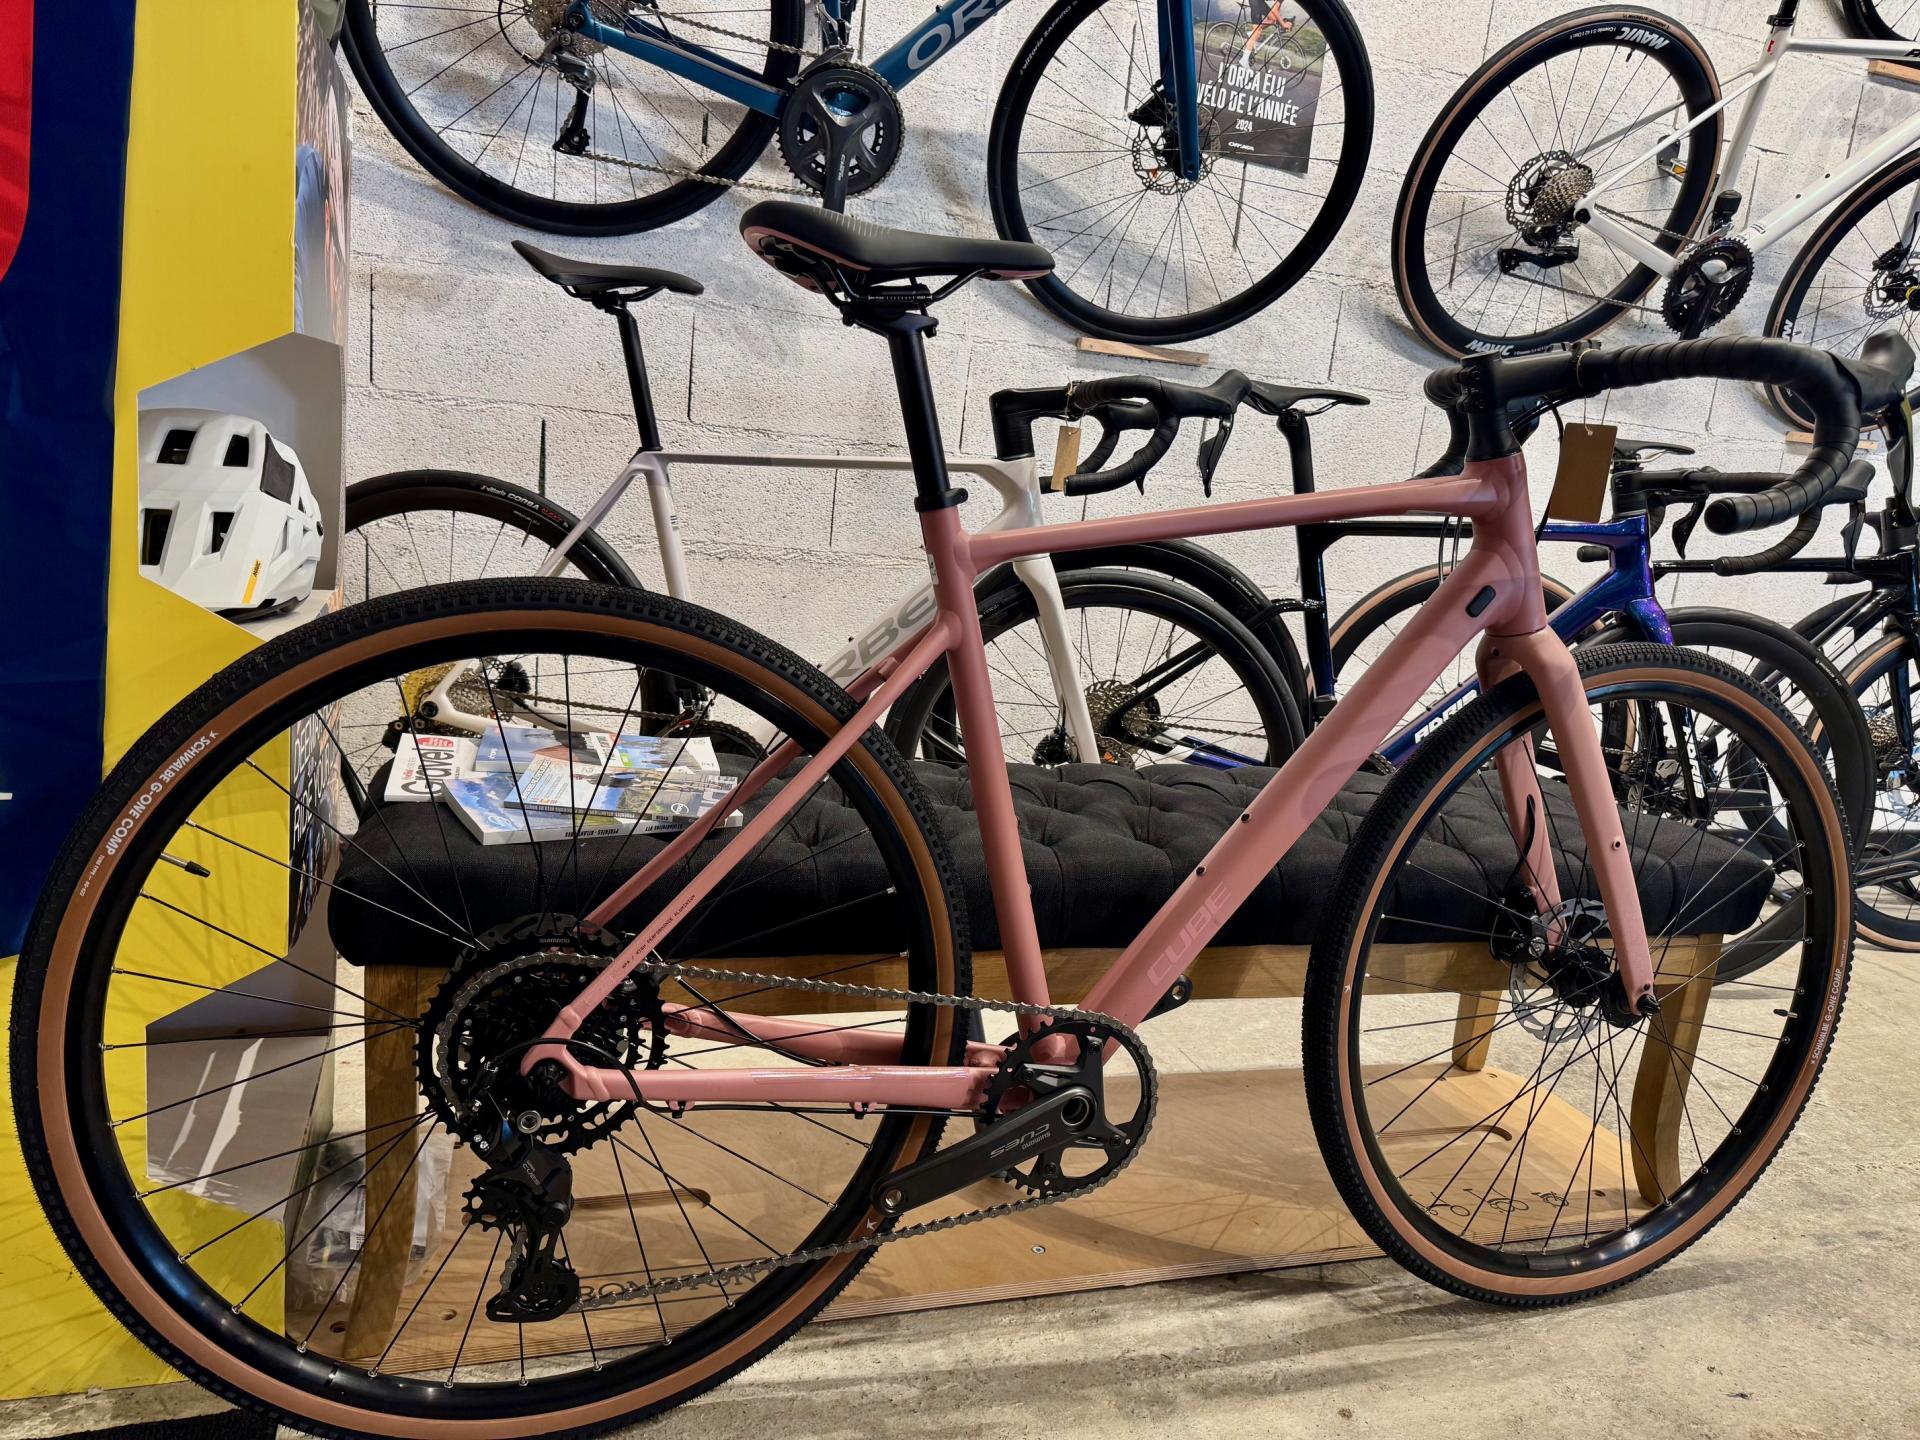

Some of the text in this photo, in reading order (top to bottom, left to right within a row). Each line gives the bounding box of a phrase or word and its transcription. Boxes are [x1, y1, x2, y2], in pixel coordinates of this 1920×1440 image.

[1614, 27, 1670, 50] MAVIC
[1218, 62, 1287, 98] L'ORCA ÉLU
[1197, 80, 1300, 127] VÉLO DE L'ANNÉE
[1235, 119, 1253, 133] 2024
[1465, 340, 1514, 356] MAVIC
[507, 492, 540, 510] CORSA
[401, 748, 455, 795] Gravel
[105, 736, 211, 856] SCHWALBE G-ONE COMP
[292, 778, 313, 851] RIDE
[647, 917, 673, 943] PERFORMANCE
[1146, 881, 1232, 986] CUBE
[1812, 968, 1843, 1060] SCHWALBE G-ONE COMP
[990, 1123, 1050, 1159] CUES
